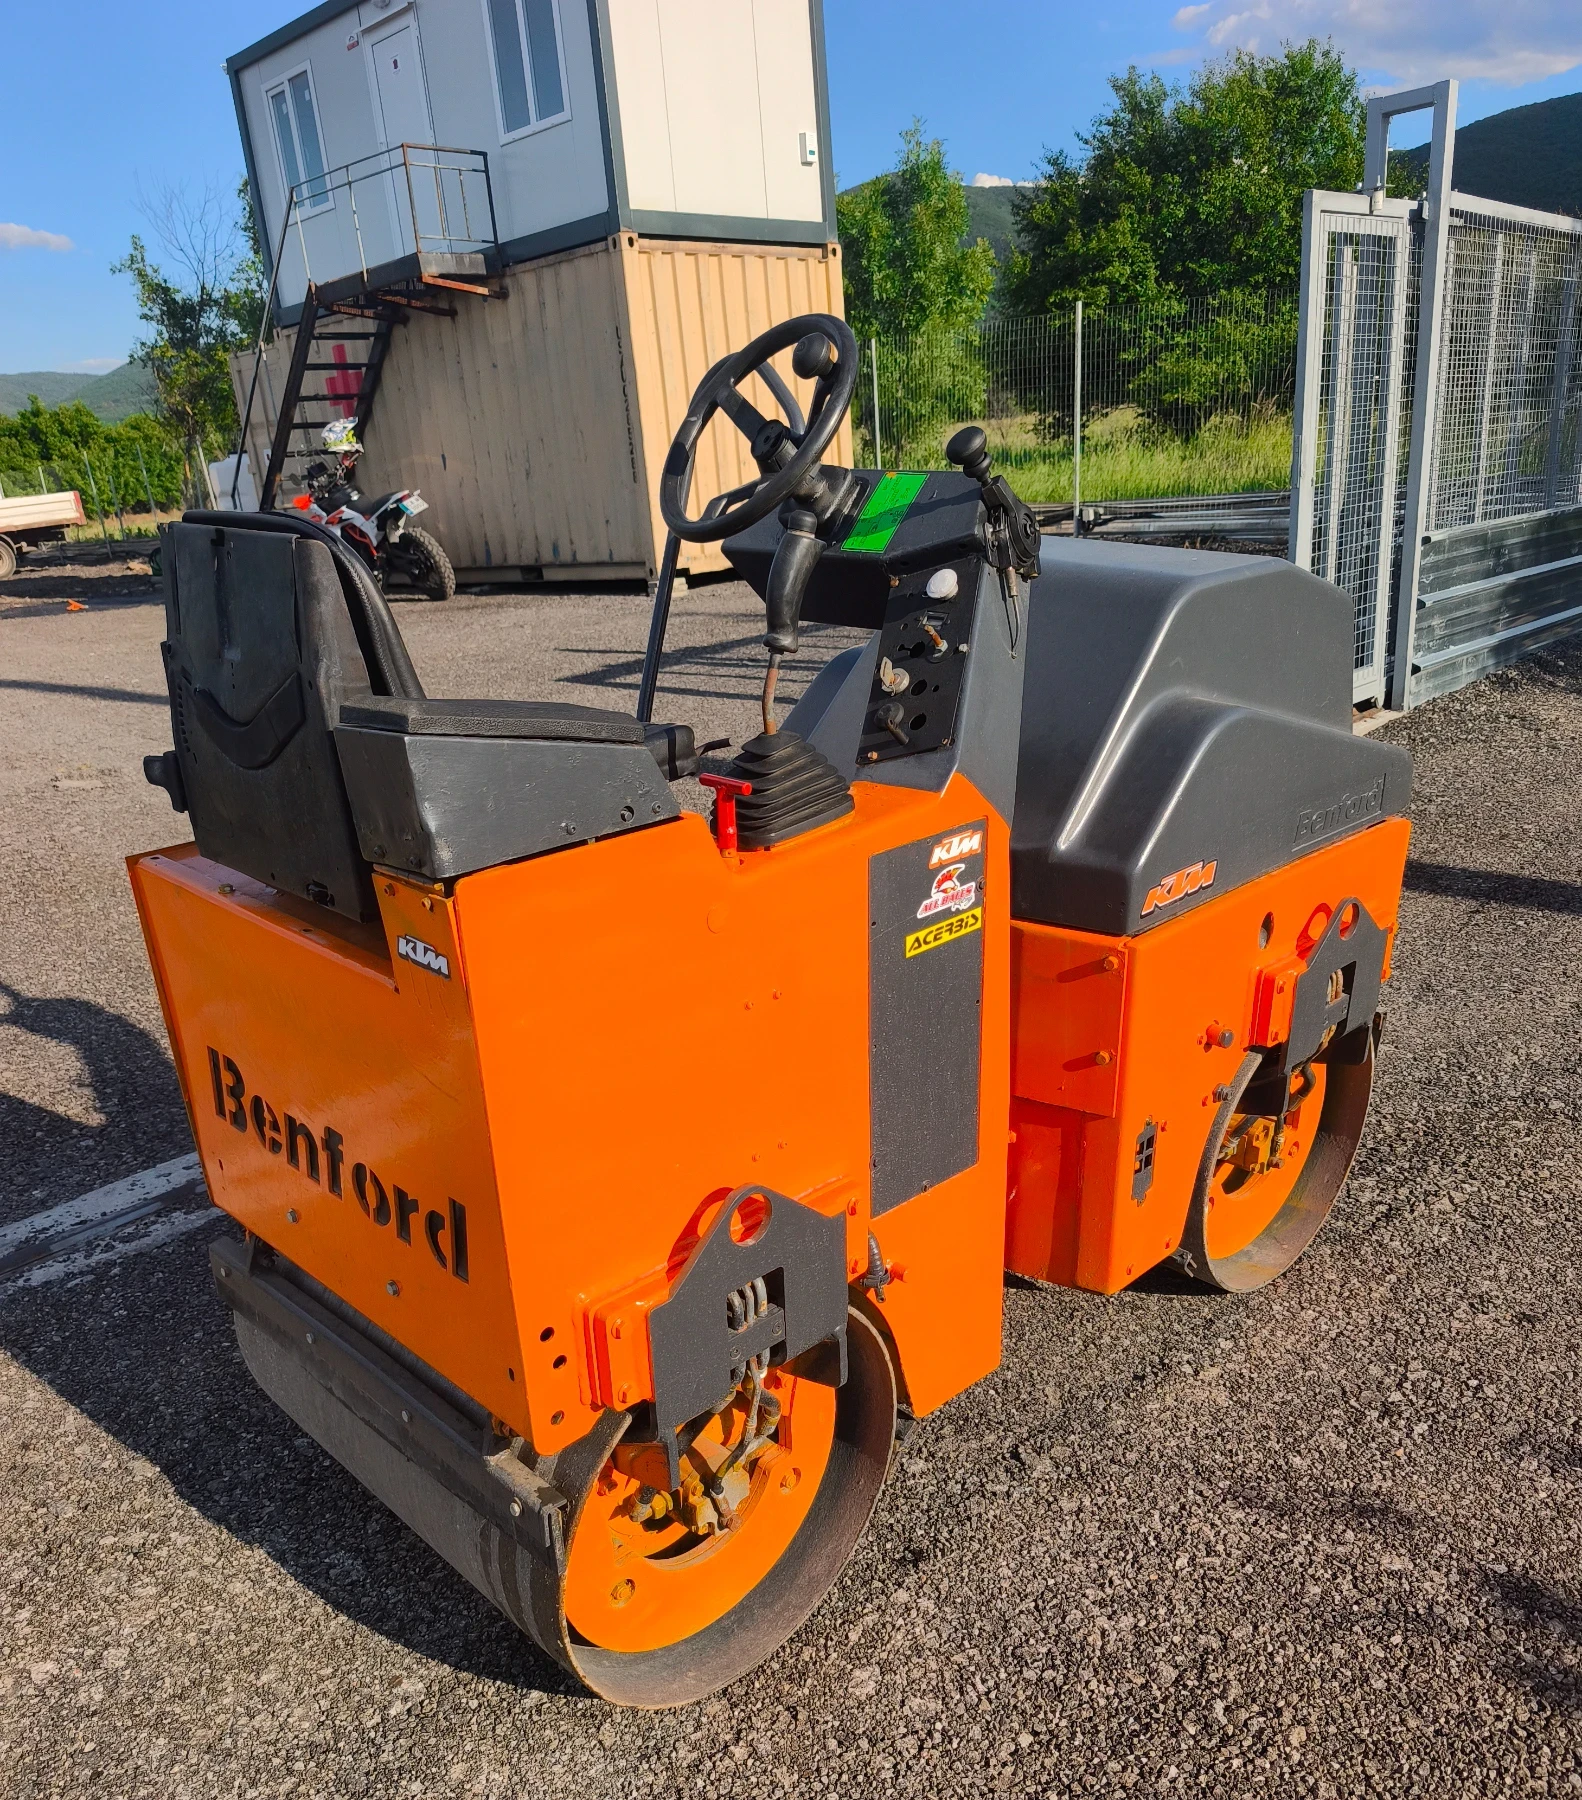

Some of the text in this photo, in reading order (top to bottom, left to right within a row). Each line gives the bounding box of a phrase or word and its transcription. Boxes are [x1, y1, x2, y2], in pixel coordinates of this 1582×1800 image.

[1293, 776, 1384, 844] Benford
[930, 830, 981, 865] KTM
[919, 898, 940, 915] ALL
[1140, 860, 1217, 917] KTM
[398, 935, 449, 976] KTM
[207, 1045, 470, 1285] Benford
